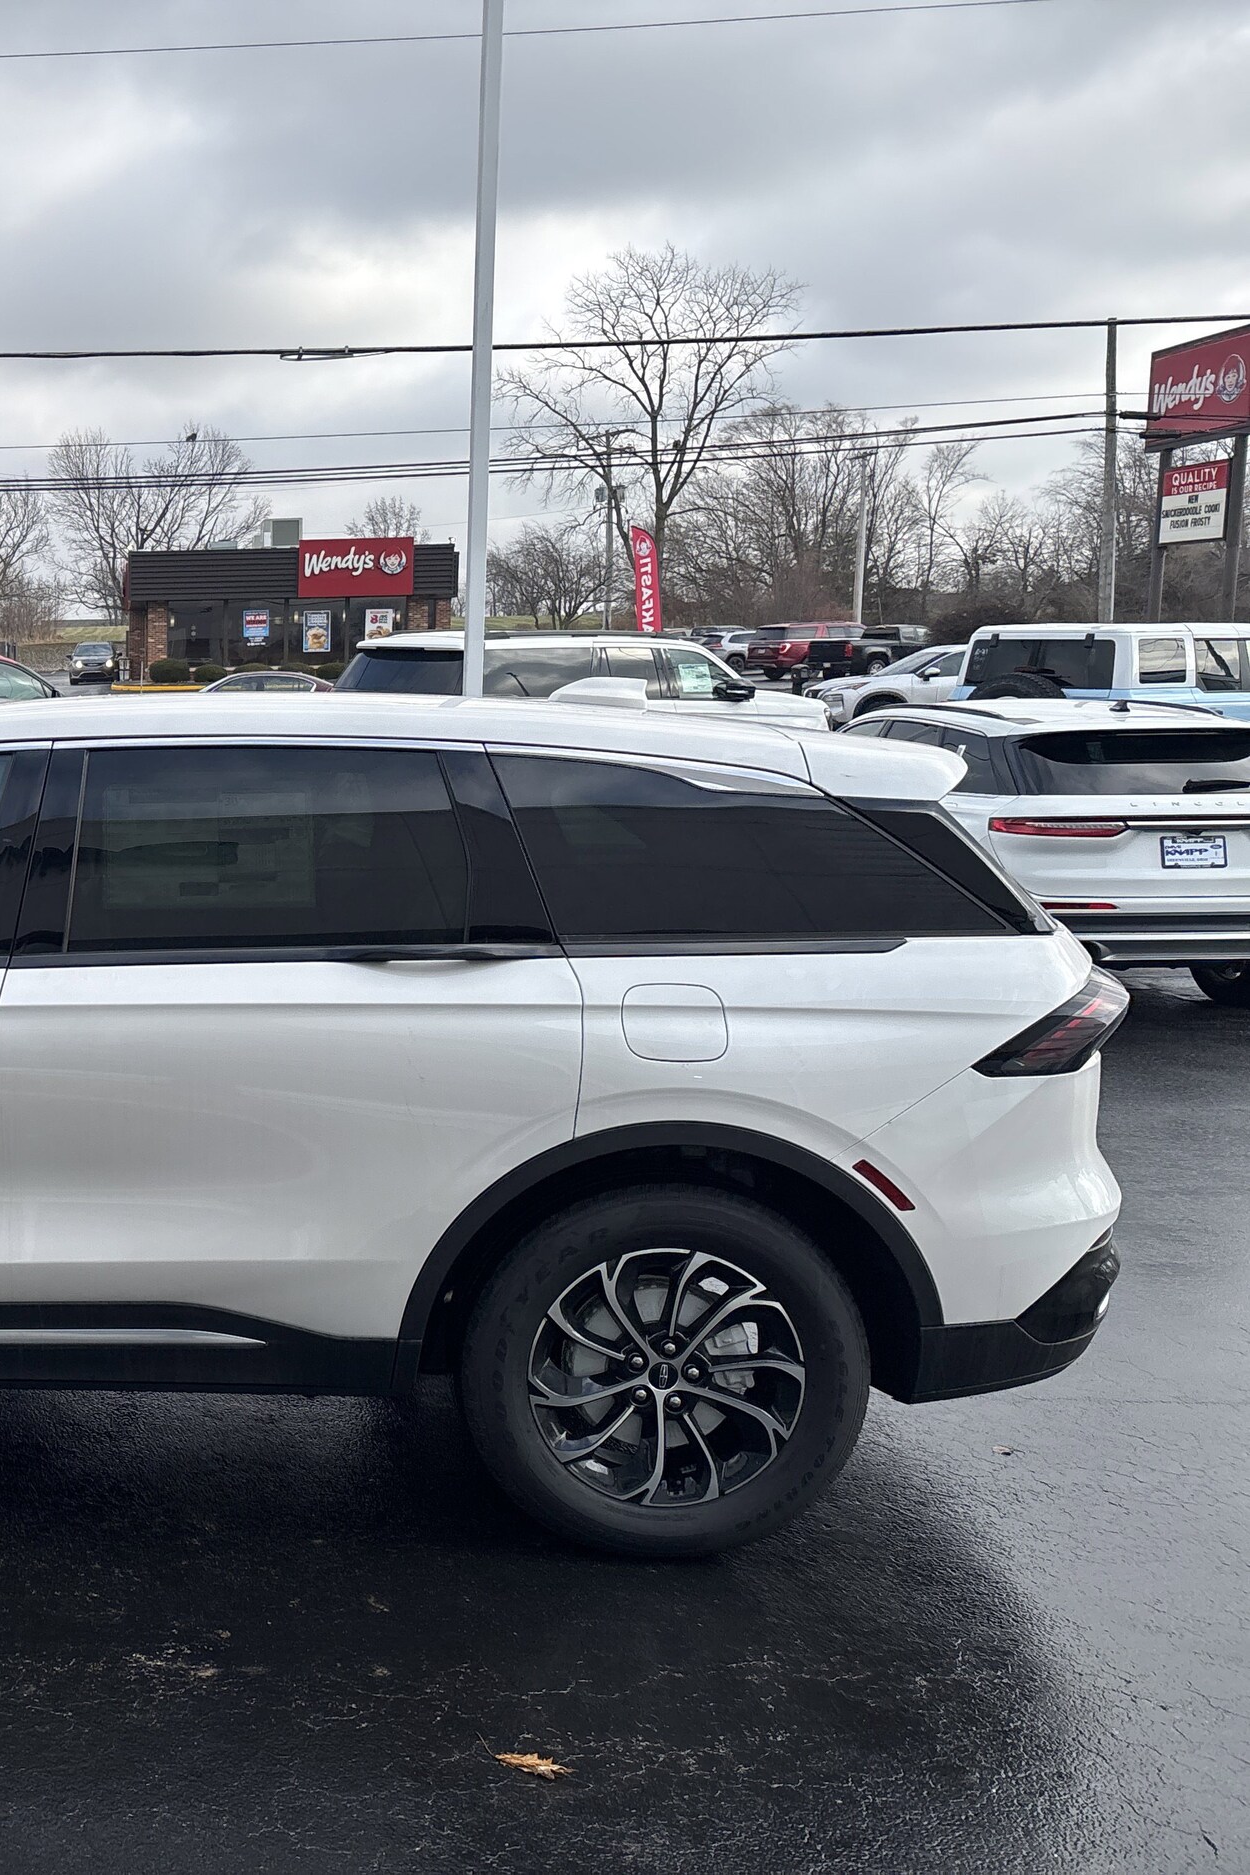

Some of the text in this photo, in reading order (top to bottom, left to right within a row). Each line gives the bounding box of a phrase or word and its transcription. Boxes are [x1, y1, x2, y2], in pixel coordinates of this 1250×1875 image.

[1152, 364, 1216, 416] Wendy's
[1172, 467, 1218, 487] QUALITY
[1171, 481, 1217, 495] IS OUR RECIPE
[1169, 516, 1211, 529] FUSION FROSTY
[304, 546, 375, 577] Wendy's
